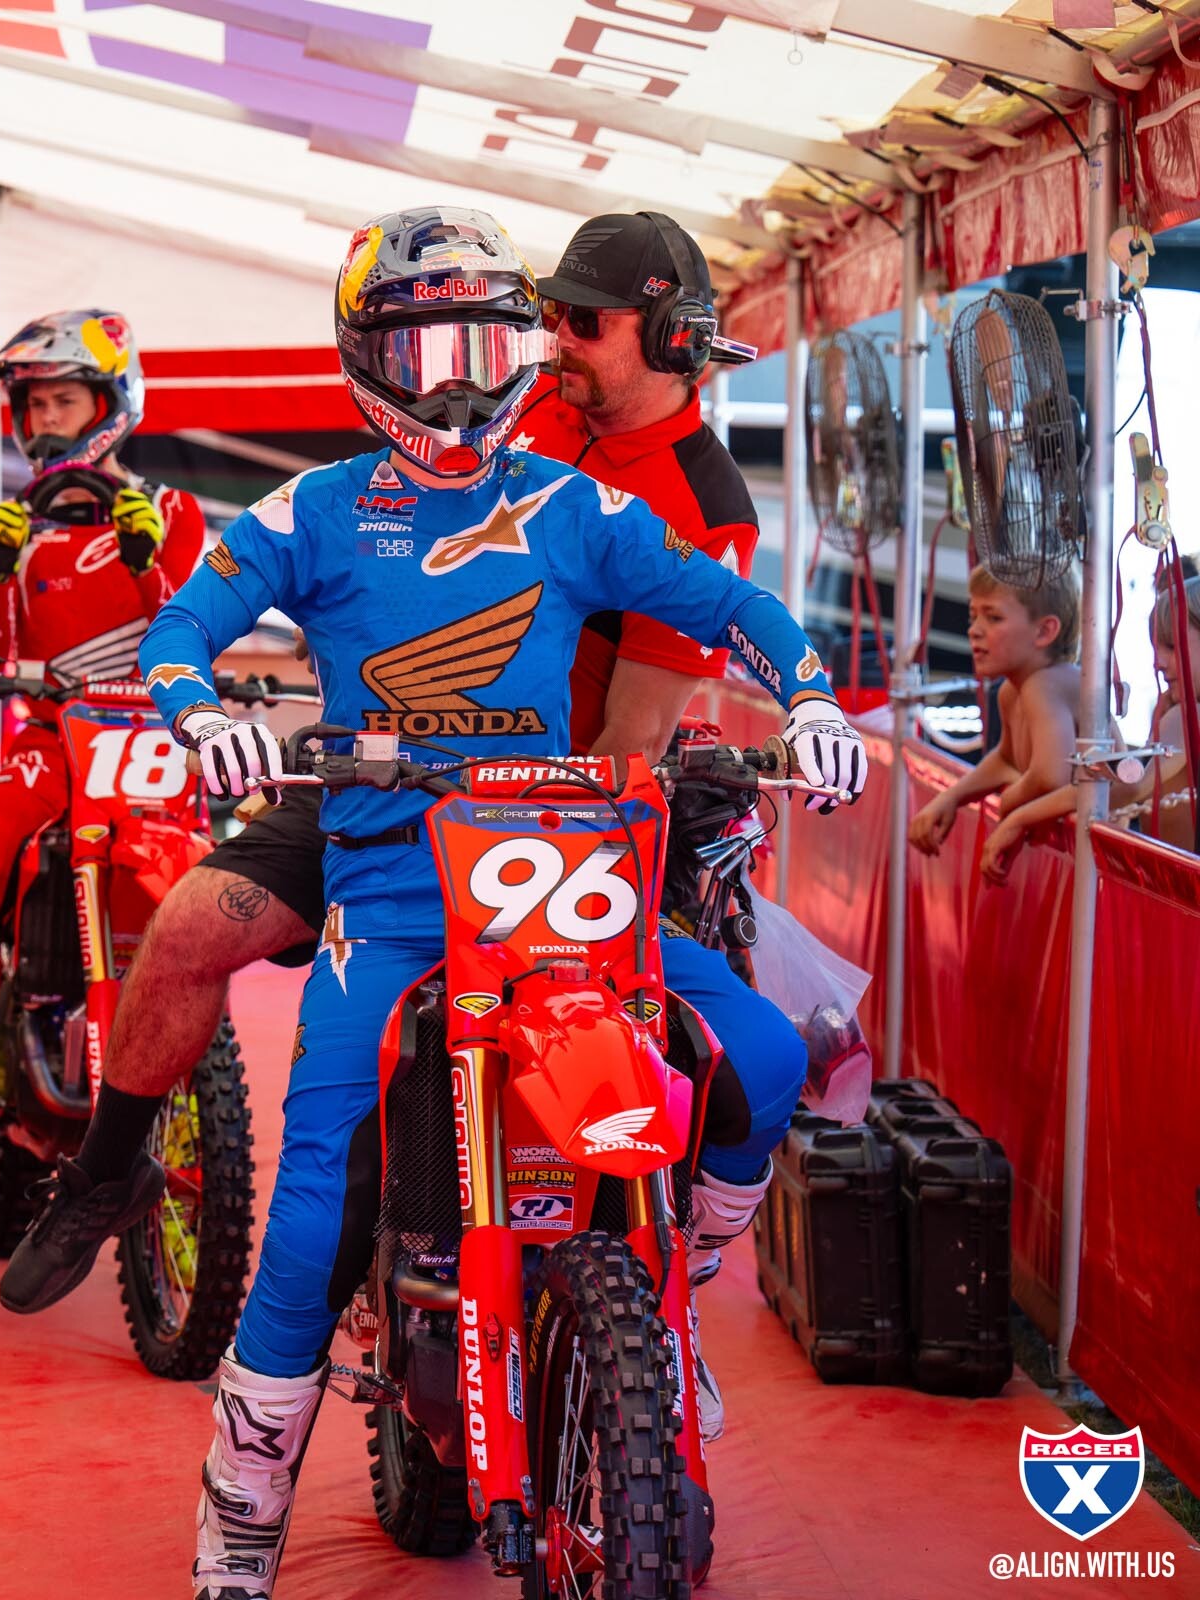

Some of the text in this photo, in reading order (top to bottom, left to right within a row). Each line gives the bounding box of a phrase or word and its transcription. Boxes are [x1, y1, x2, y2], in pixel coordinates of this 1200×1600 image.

[414, 277, 488, 301] Red Bull
[386, 412, 433, 465] Bull
[354, 496, 418, 517] HRC
[376, 539, 414, 548] QUAD
[376, 548, 414, 557] LOCK
[87, 684, 147, 695] RENTH
[364, 710, 546, 736] HONDA
[84, 728, 188, 800] 18
[477, 767, 603, 781] RENTHAL
[469, 836, 639, 945] 96
[528, 945, 590, 954] HONDA
[584, 1140, 667, 1155] HONDA
[507, 1170, 576, 1182] HINSON
[417, 1254, 457, 1264] Twin Air
[462, 1297, 488, 1472] DUNLOP
[512, 1352, 524, 1422] WISECO
